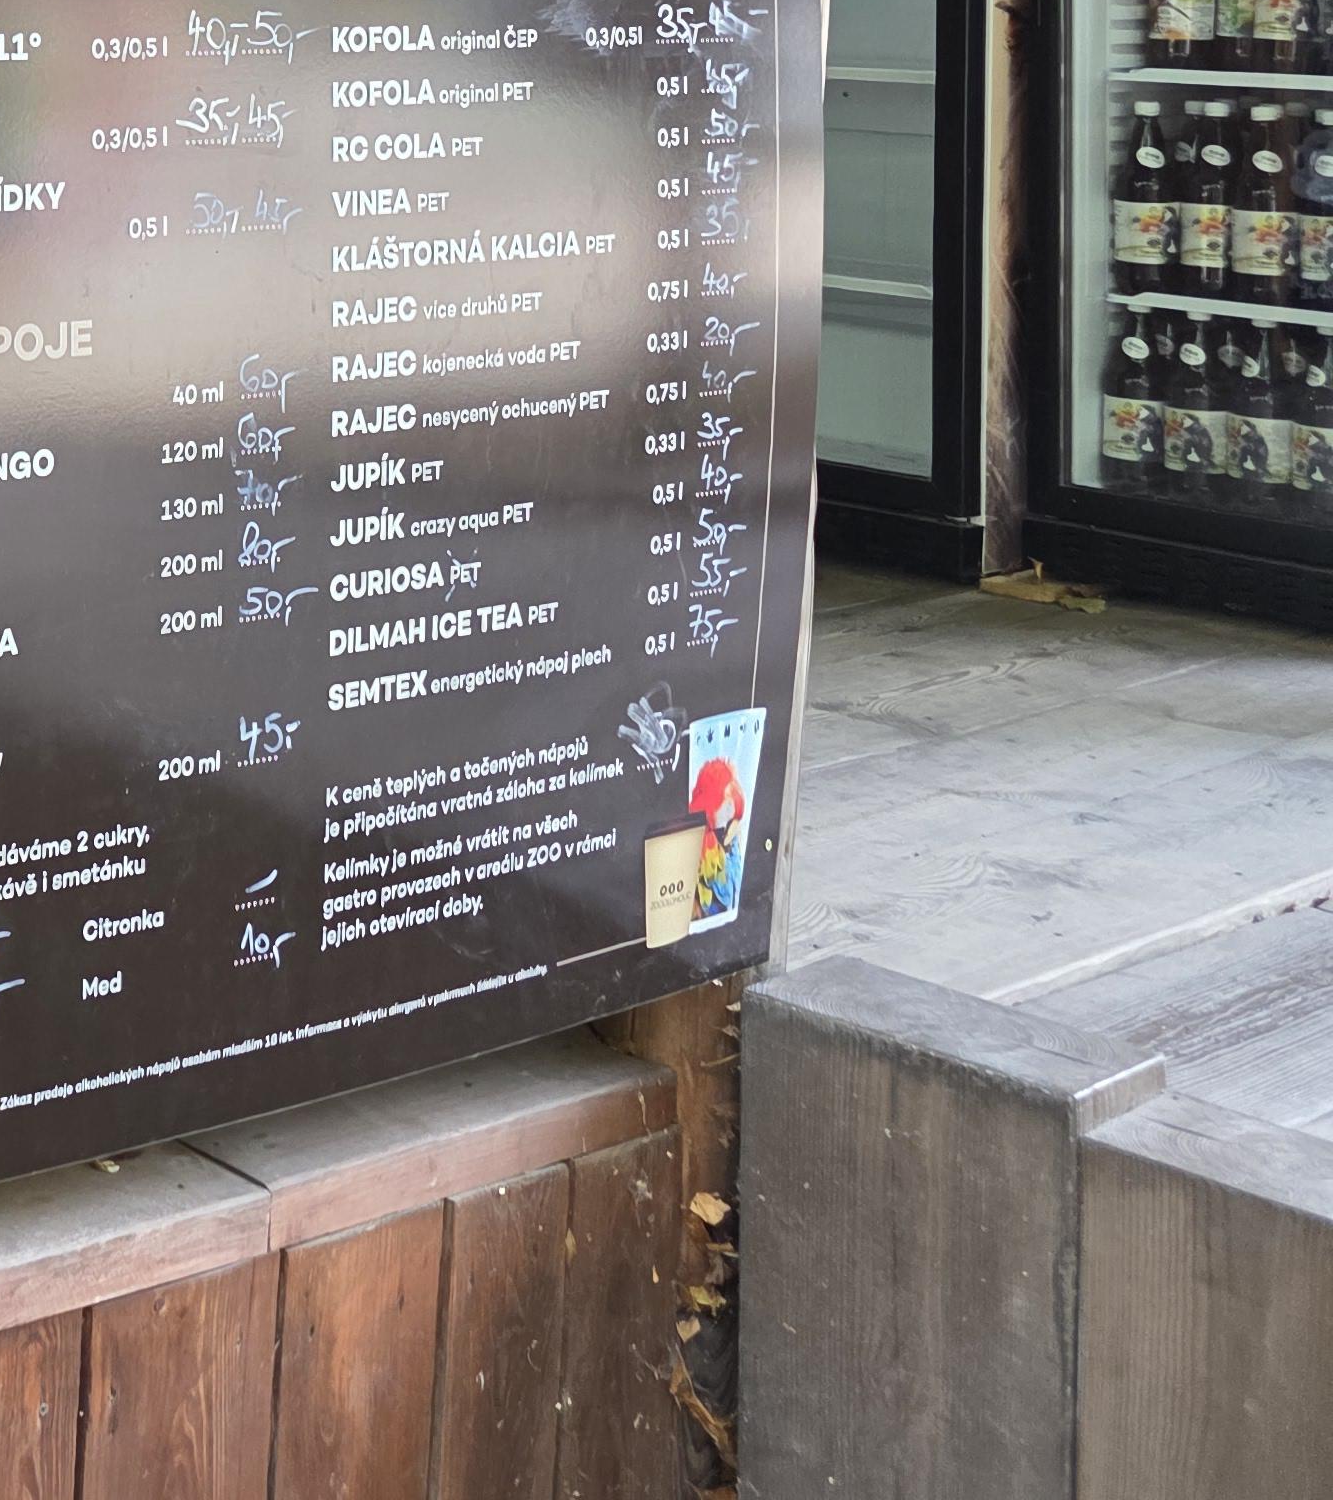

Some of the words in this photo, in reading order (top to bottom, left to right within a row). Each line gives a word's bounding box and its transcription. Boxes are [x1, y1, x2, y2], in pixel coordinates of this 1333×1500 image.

[333, 25, 435, 52] KOFOLA
[441, 30, 500, 54] original
[504, 25, 537, 48] ČEP
[333, 230, 485, 272] KLÁŠTORNÁ
[492, 231, 580, 261] KALCIA
[423, 348, 503, 376] kojenecká
[423, 401, 499, 430] nesycený
[502, 393, 576, 418] ochucený
[162, 441, 197, 464] 120
[202, 437, 223, 459] ml
[330, 507, 404, 546] JUPÍK
[411, 517, 455, 537] crazy
[459, 512, 499, 534] aqua
[330, 562, 444, 601] CURIOSA
[330, 617, 425, 656] DILMAH
[329, 670, 427, 710] SEMTEX
[431, 660, 523, 693] energetický
[539, 736, 588, 765] nápojů
[94, 824, 149, 848] cukry,
[325, 854, 389, 884] Kelímky
[83, 909, 163, 941] Citronka
[0, 1094, 32, 1110] Zákaz
[35, 1083, 73, 1105] prodeje
